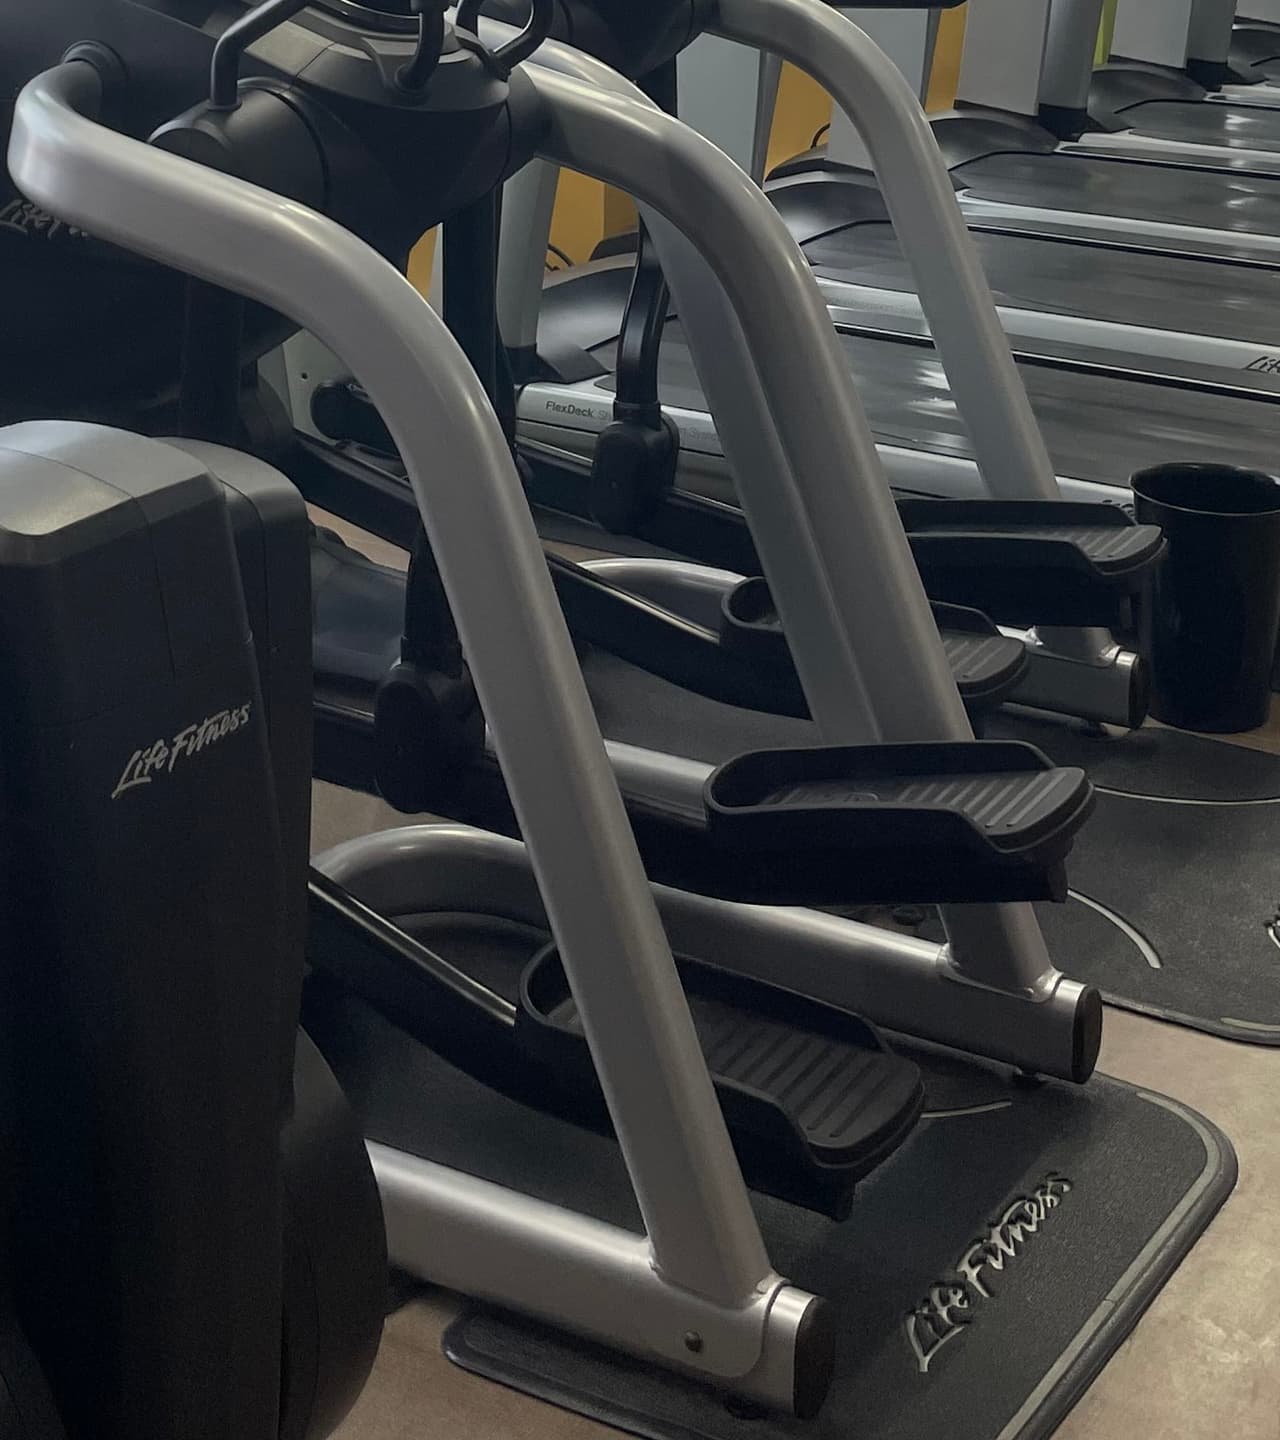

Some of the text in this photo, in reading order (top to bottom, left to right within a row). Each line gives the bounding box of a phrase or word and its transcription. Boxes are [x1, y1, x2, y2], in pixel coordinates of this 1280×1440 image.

[546, 400, 594, 418] FlexDeck
[111, 701, 252, 800] Life Fitness
[905, 1173, 1072, 1373] Life Fitness
